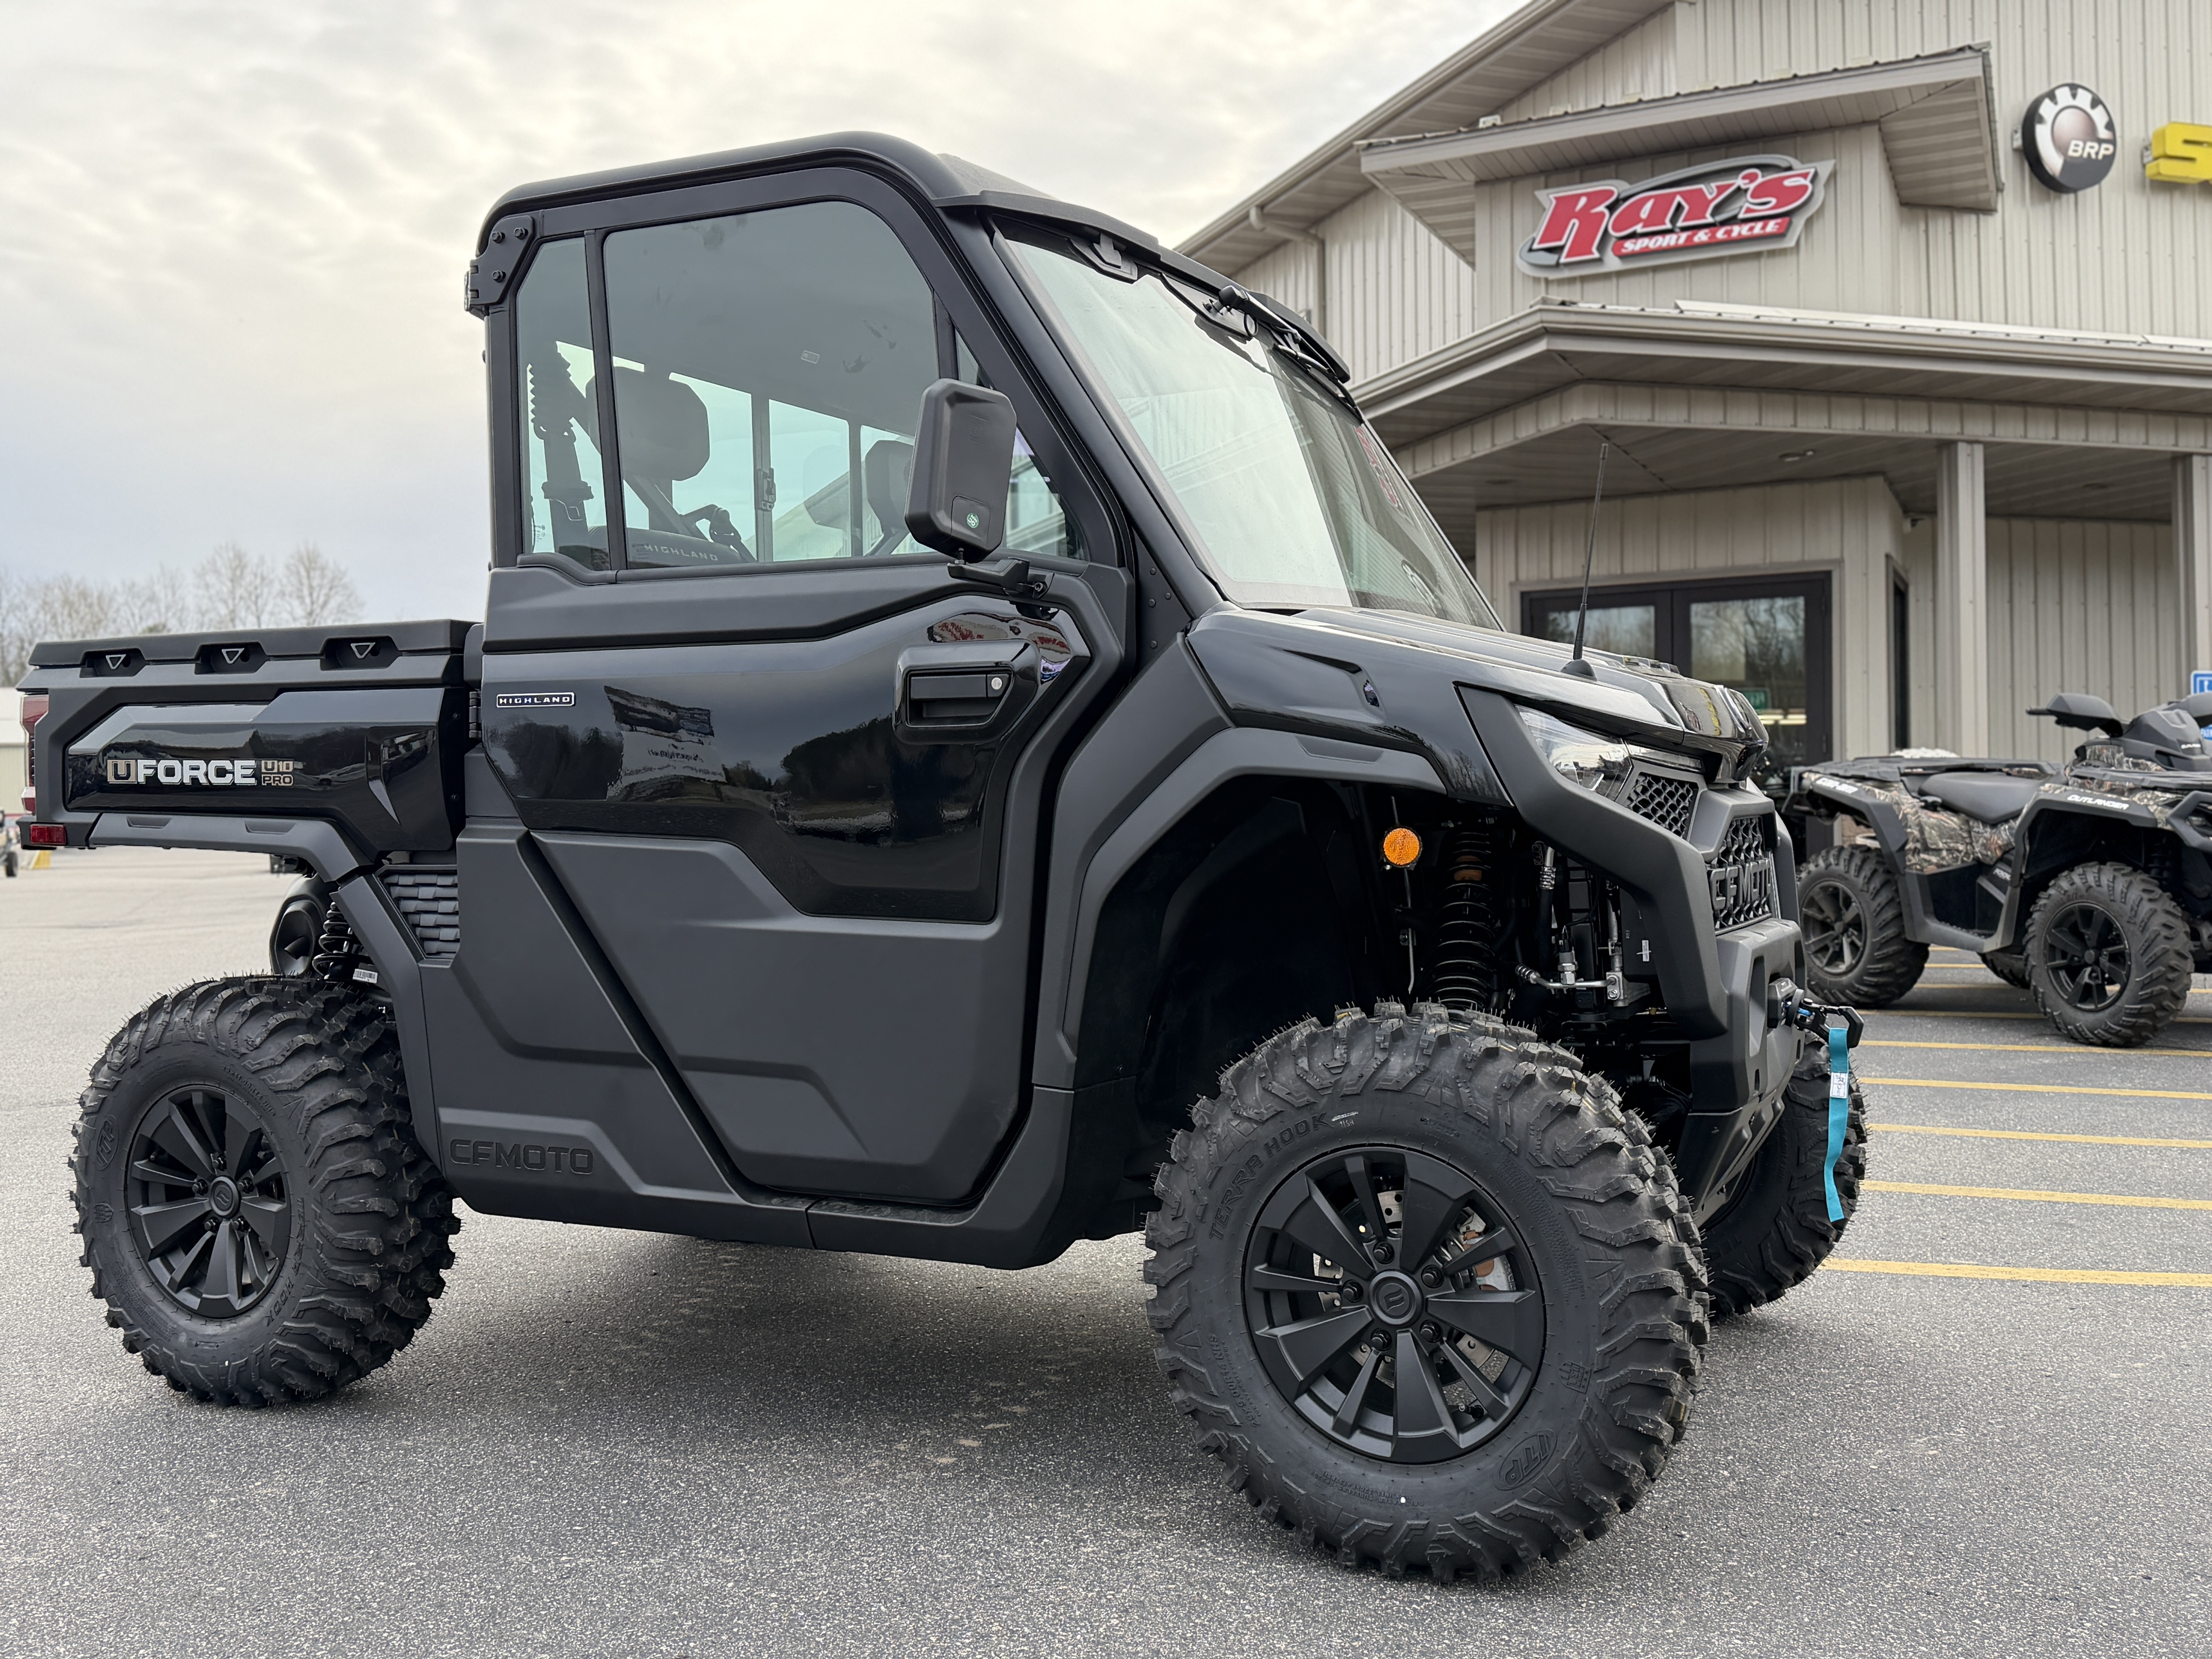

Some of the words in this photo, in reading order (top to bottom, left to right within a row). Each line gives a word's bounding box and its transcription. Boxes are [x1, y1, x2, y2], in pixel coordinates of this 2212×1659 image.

[2068, 139, 2114, 160] BRP
[1621, 231, 1692, 252] SPORT
[1693, 230, 1711, 242] &
[1715, 220, 1781, 238] CYCLE
[644, 544, 718, 561] HIGHLAND
[500, 696, 570, 704] HIGHLAND
[261, 760, 294, 772] U10
[262, 775, 294, 786] PRO
[2067, 795, 2129, 810] OUTLANDER
[450, 1139, 593, 1175] CFMOTO
[1209, 1154, 1264, 1240] TERRA
[1264, 1111, 1335, 1158] HOOK
[292, 1197, 306, 1276] TERRA
[265, 1276, 294, 1327] HOOK
[1505, 1434, 1550, 1487] ITP
